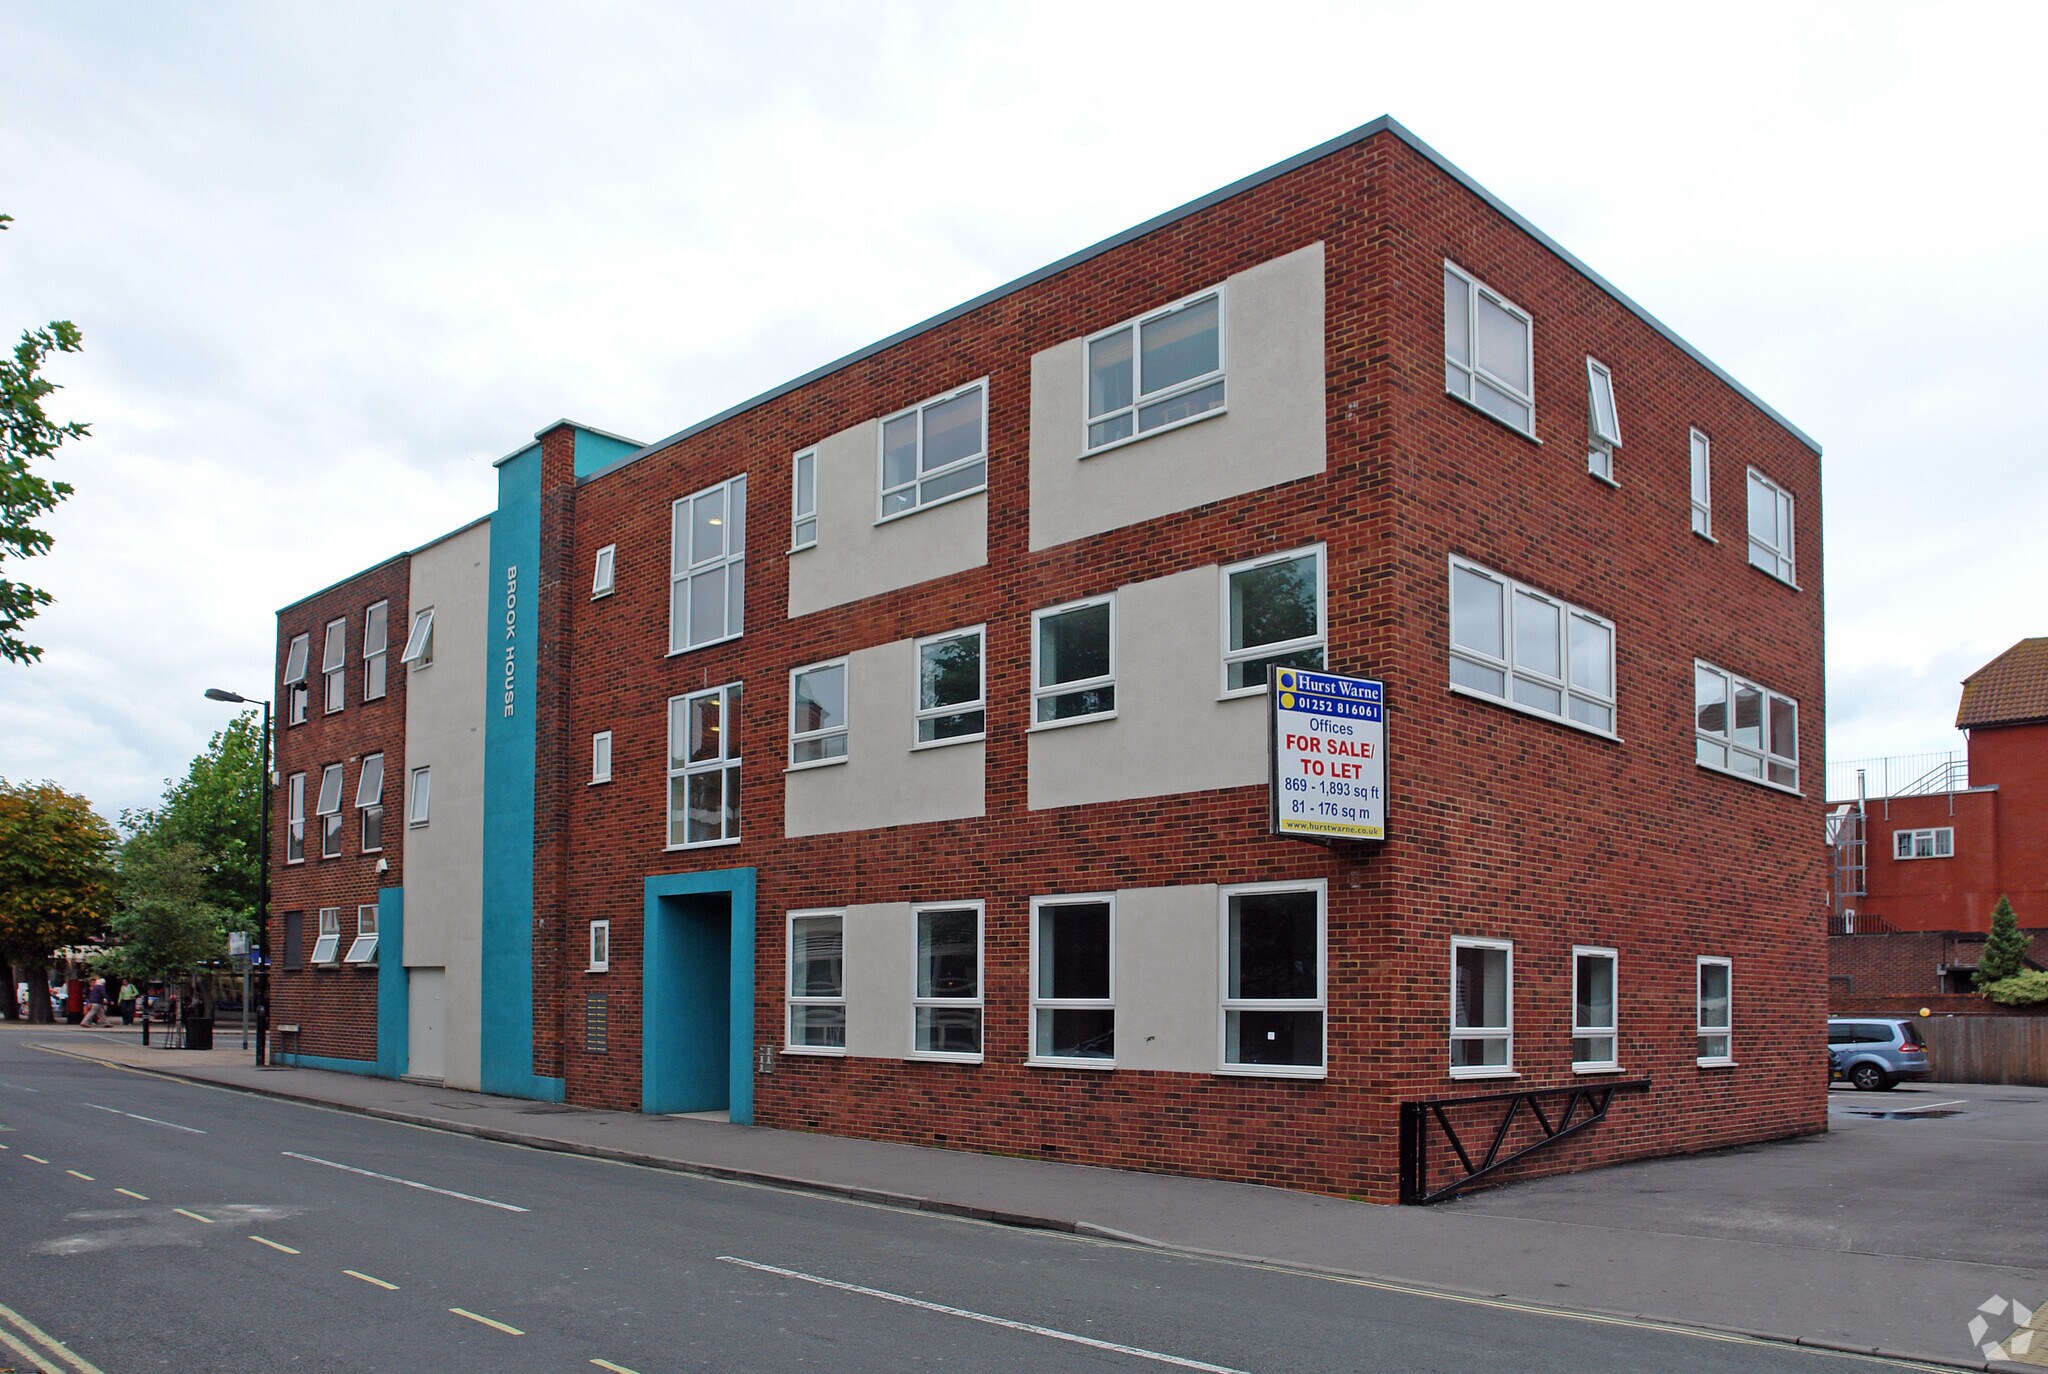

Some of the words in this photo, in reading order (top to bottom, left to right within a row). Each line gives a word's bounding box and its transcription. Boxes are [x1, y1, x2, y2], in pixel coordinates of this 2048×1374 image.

[506, 565, 517, 640] BROOK
[504, 646, 515, 718] HOUSE
[1299, 675, 1336, 694] Hurst
[1338, 680, 1379, 700] Warne
[1299, 698, 1333, 713] 01252
[1337, 703, 1378, 718] 816061
[1309, 717, 1354, 736] Offices
[1286, 733, 1322, 754] FOR
[1327, 739, 1376, 760] SALE/
[1300, 758, 1325, 777] TO
[1331, 762, 1363, 780] LET
[1285, 777, 1307, 792] 869
[1319, 780, 1351, 797] 1,893
[1354, 787, 1368, 801] sq
[1371, 785, 1379, 800] ft
[1292, 799, 1305, 814] 81
[1318, 801, 1338, 816] 176
[1341, 806, 1356, 821] sq
[1359, 807, 1370, 819] m
[1286, 820, 1378, 835] www.hurstwarne.co.uk
